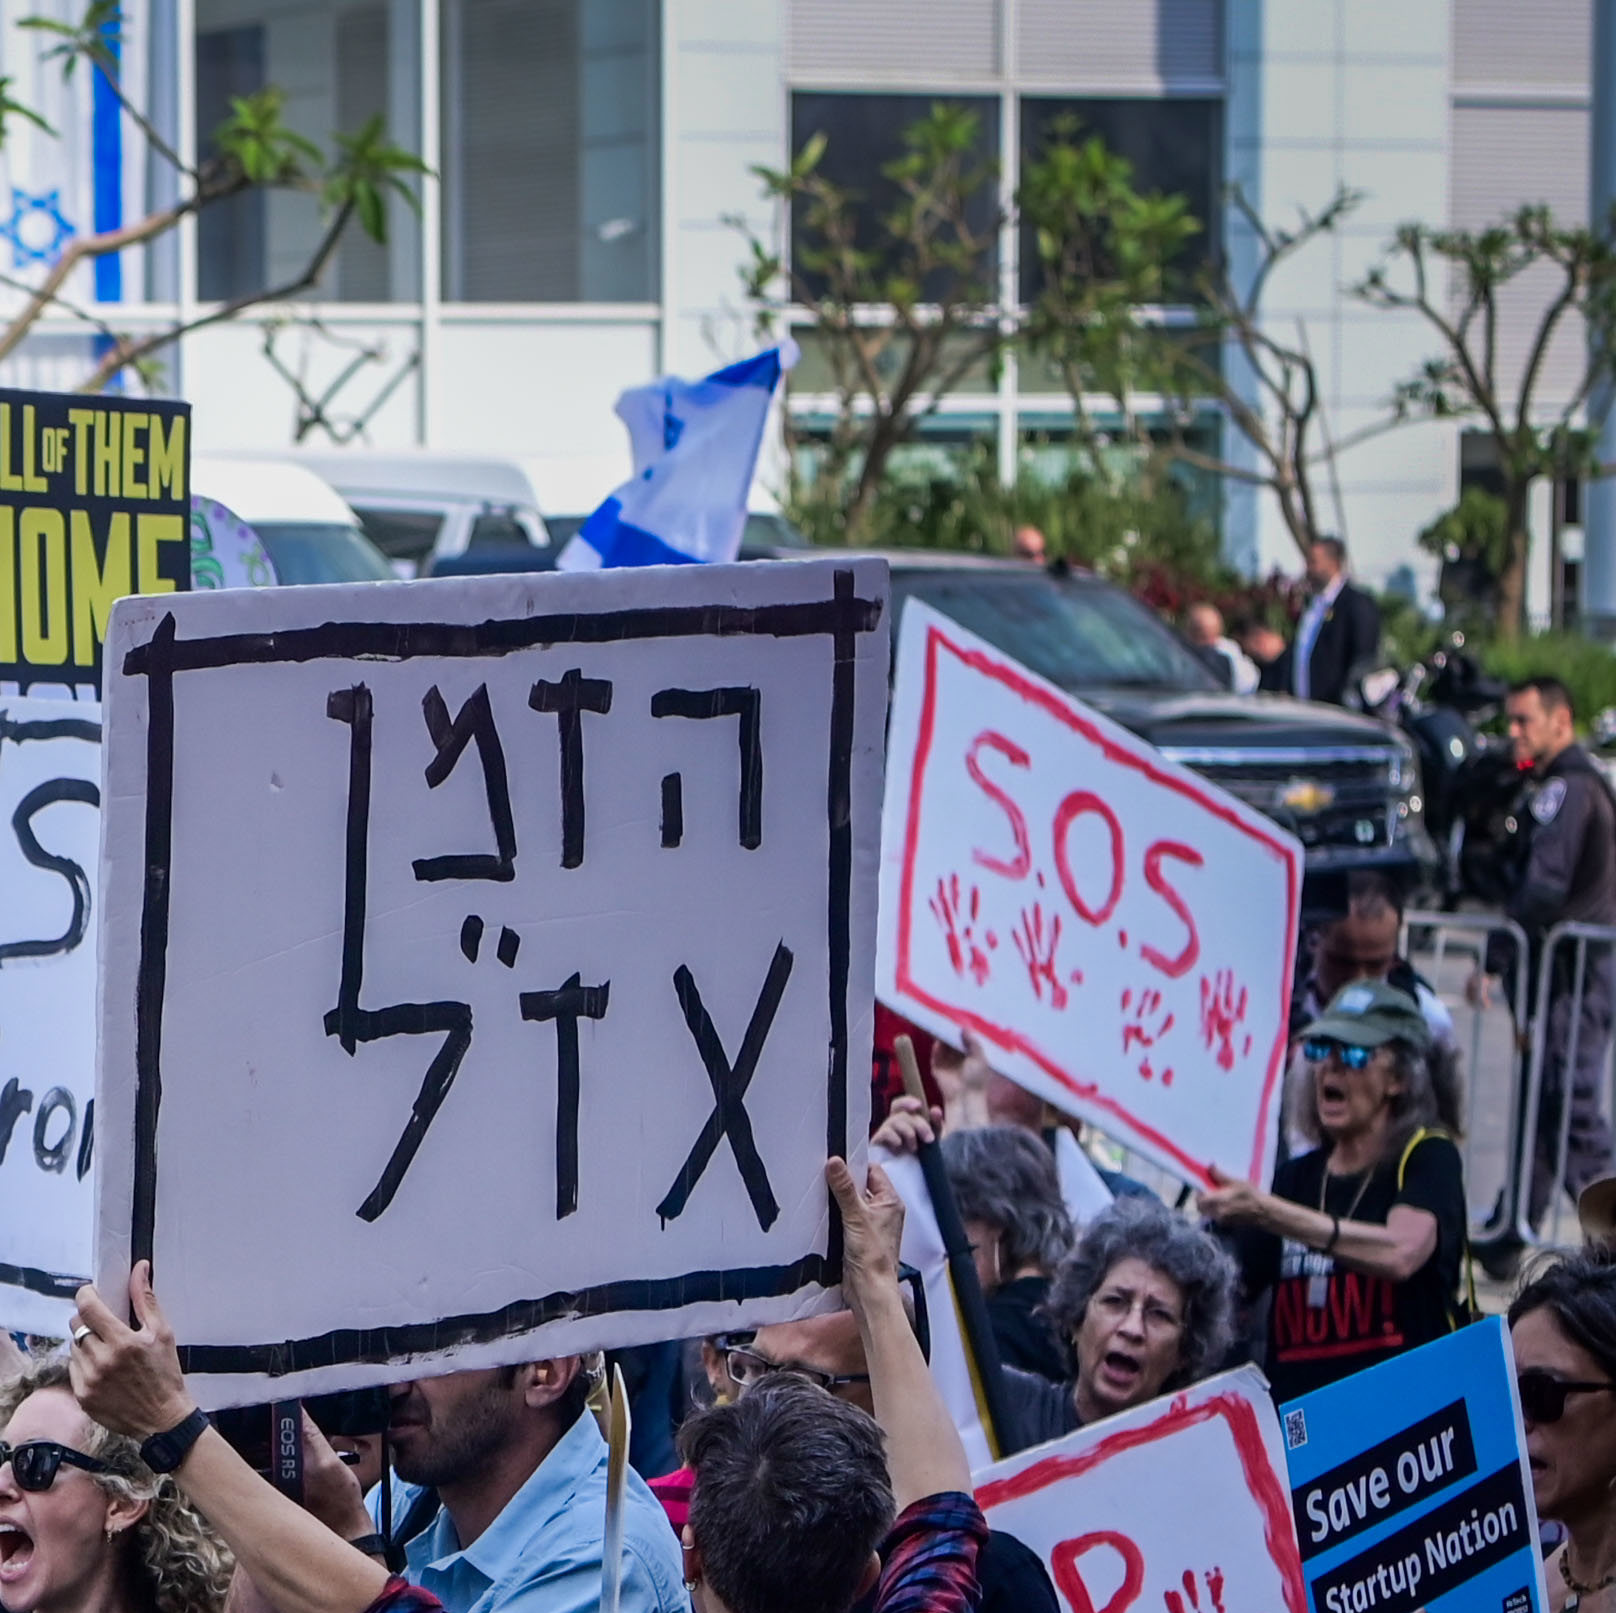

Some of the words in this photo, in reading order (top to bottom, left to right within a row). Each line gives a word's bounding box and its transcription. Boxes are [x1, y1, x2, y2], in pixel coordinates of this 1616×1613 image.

[42, 427, 69, 473] OF
[68, 408, 185, 500] THEM
[327, 669, 763, 1055] הזמן
[281, 1417, 295, 1456] EOS
[1306, 1467, 1391, 1543] Save
[1397, 1425, 1454, 1494] our
[1424, 1502, 1518, 1575] Nation
